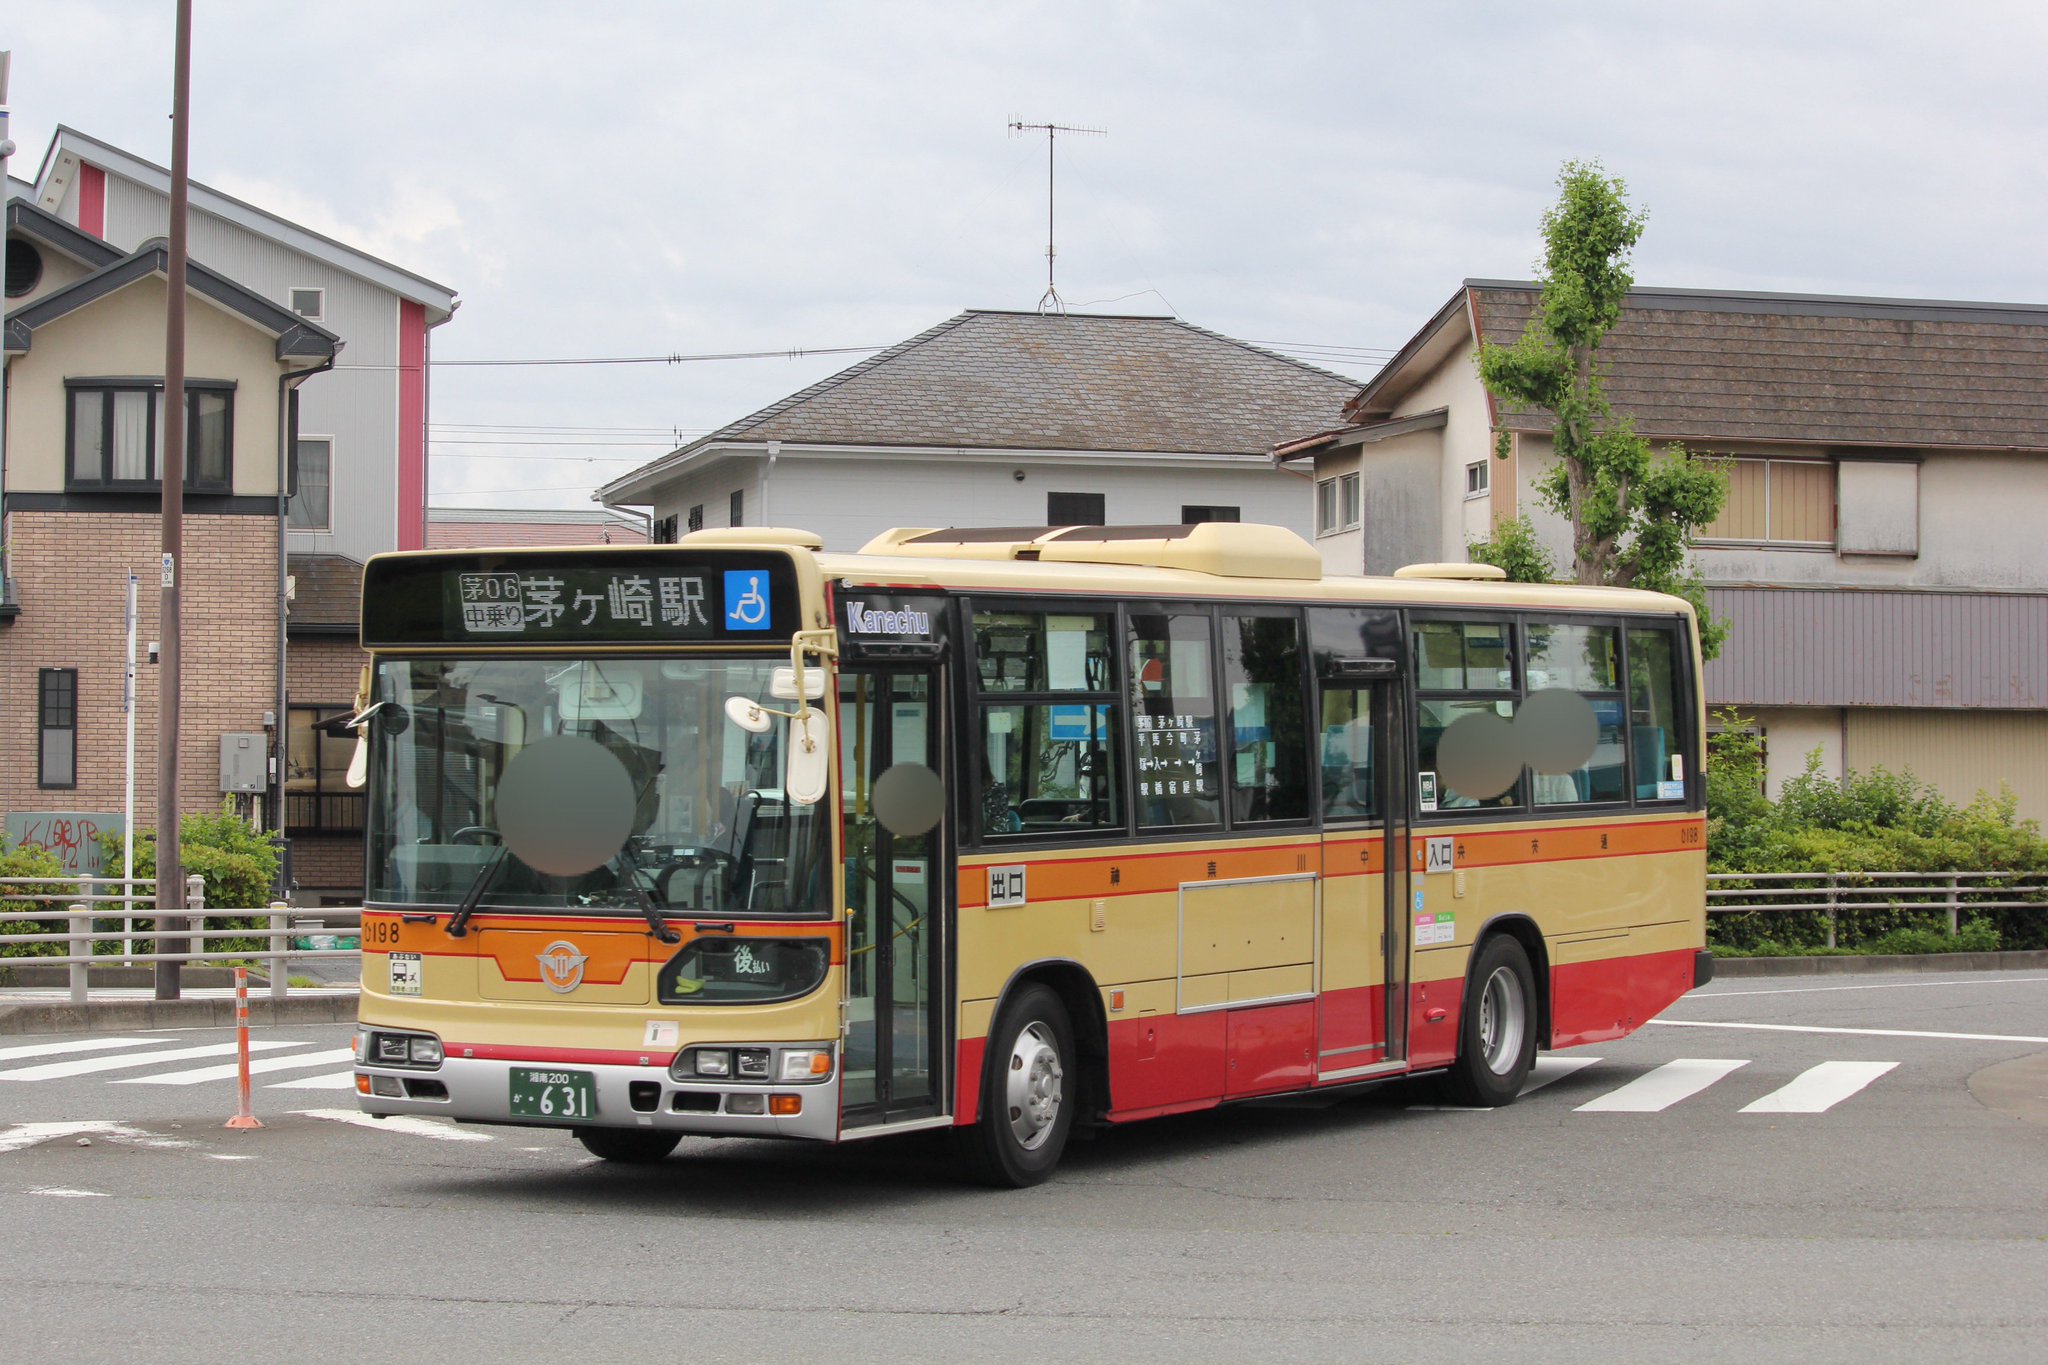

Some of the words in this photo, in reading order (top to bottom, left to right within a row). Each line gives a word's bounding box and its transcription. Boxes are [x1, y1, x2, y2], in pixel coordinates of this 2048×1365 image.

[465, 605, 523, 629] 中乗り
[846, 601, 930, 635] Kanachu
[1428, 843, 1452, 867] 入口
[991, 872, 1023, 900] 出口
[734, 944, 770, 974] 後払い
